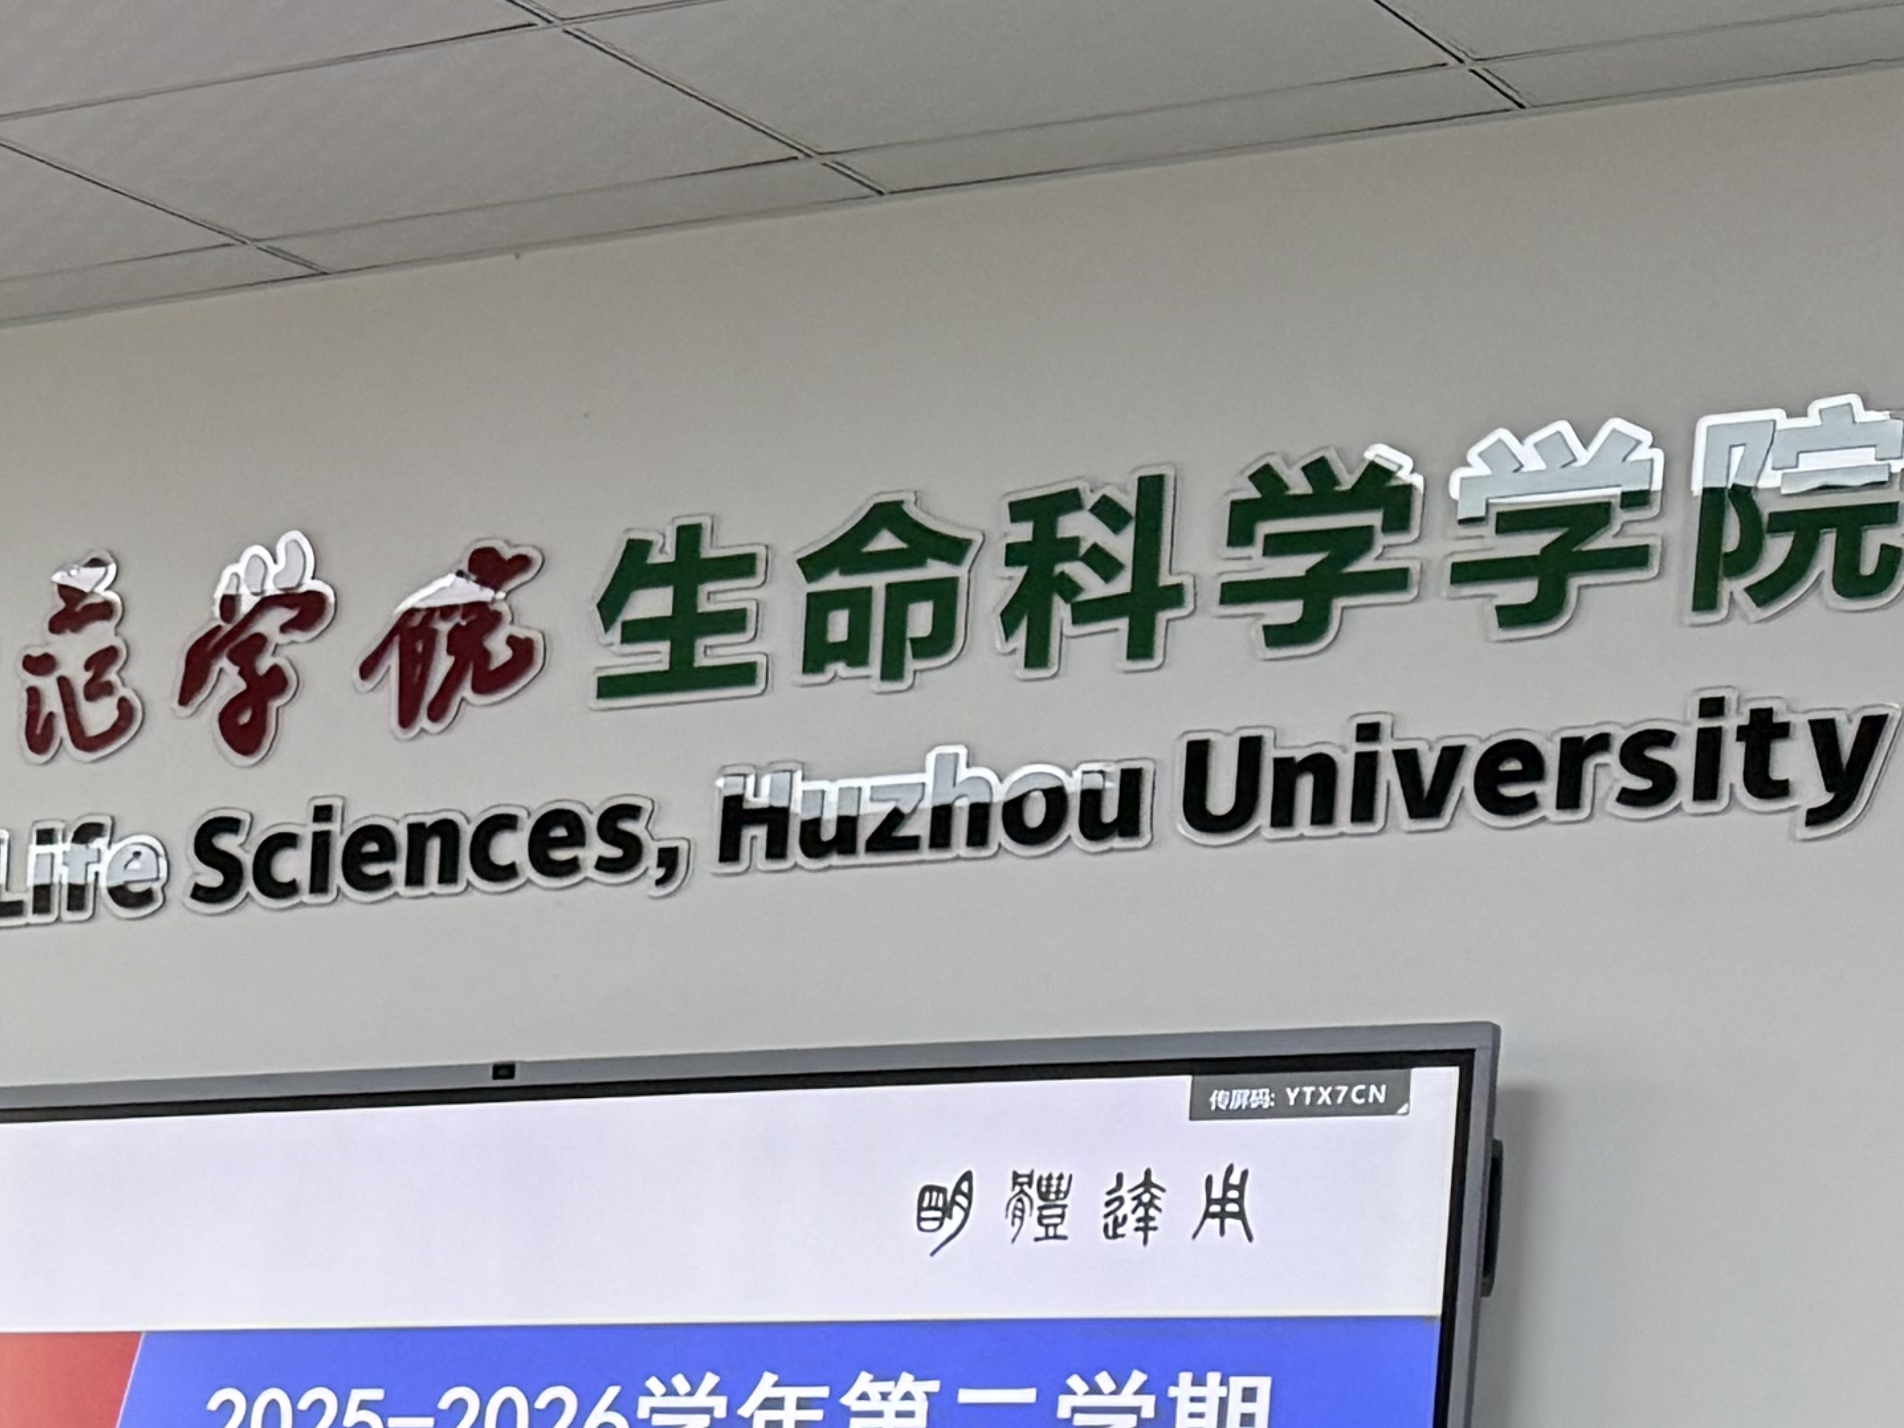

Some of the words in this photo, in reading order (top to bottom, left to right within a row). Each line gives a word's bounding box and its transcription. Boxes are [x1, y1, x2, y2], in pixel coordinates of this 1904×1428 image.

[596, 402, 1904, 700] 生命科学学院
[191, 799, 682, 907] Sciences,
[718, 754, 1140, 862] Huzhou
[1190, 695, 1888, 833] University
[1285, 1083, 1388, 1108] YTX7CN
